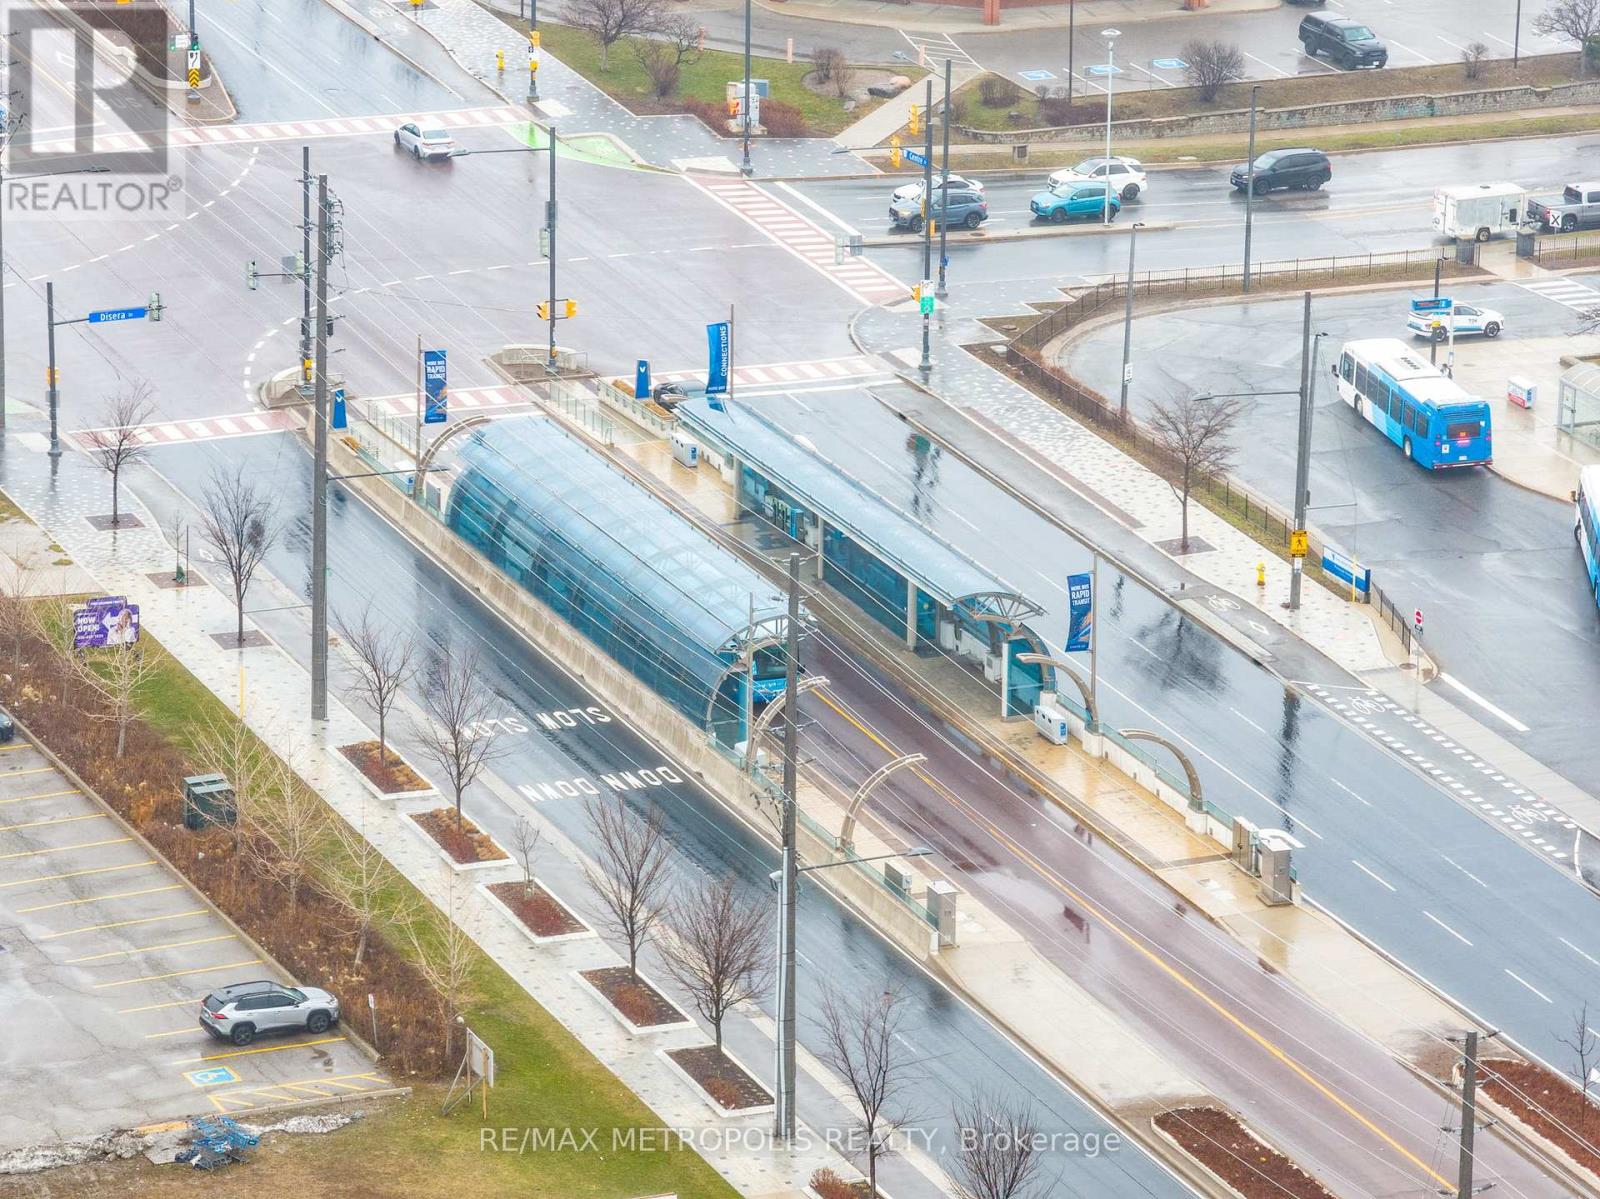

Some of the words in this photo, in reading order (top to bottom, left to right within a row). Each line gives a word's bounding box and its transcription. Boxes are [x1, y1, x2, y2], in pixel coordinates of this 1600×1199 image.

[100, 312, 126, 321] Disera
[719, 325, 728, 377] CONNECTIONS
[426, 365, 446, 373] RAPID
[1071, 590, 1090, 600] RAPID
[1072, 598, 1091, 606] TRANSIT
[76, 616, 97, 624] NOW
[536, 706, 612, 730] SLOW
[600, 766, 684, 791] DOWN
[518, 777, 600, 802] DOWN
